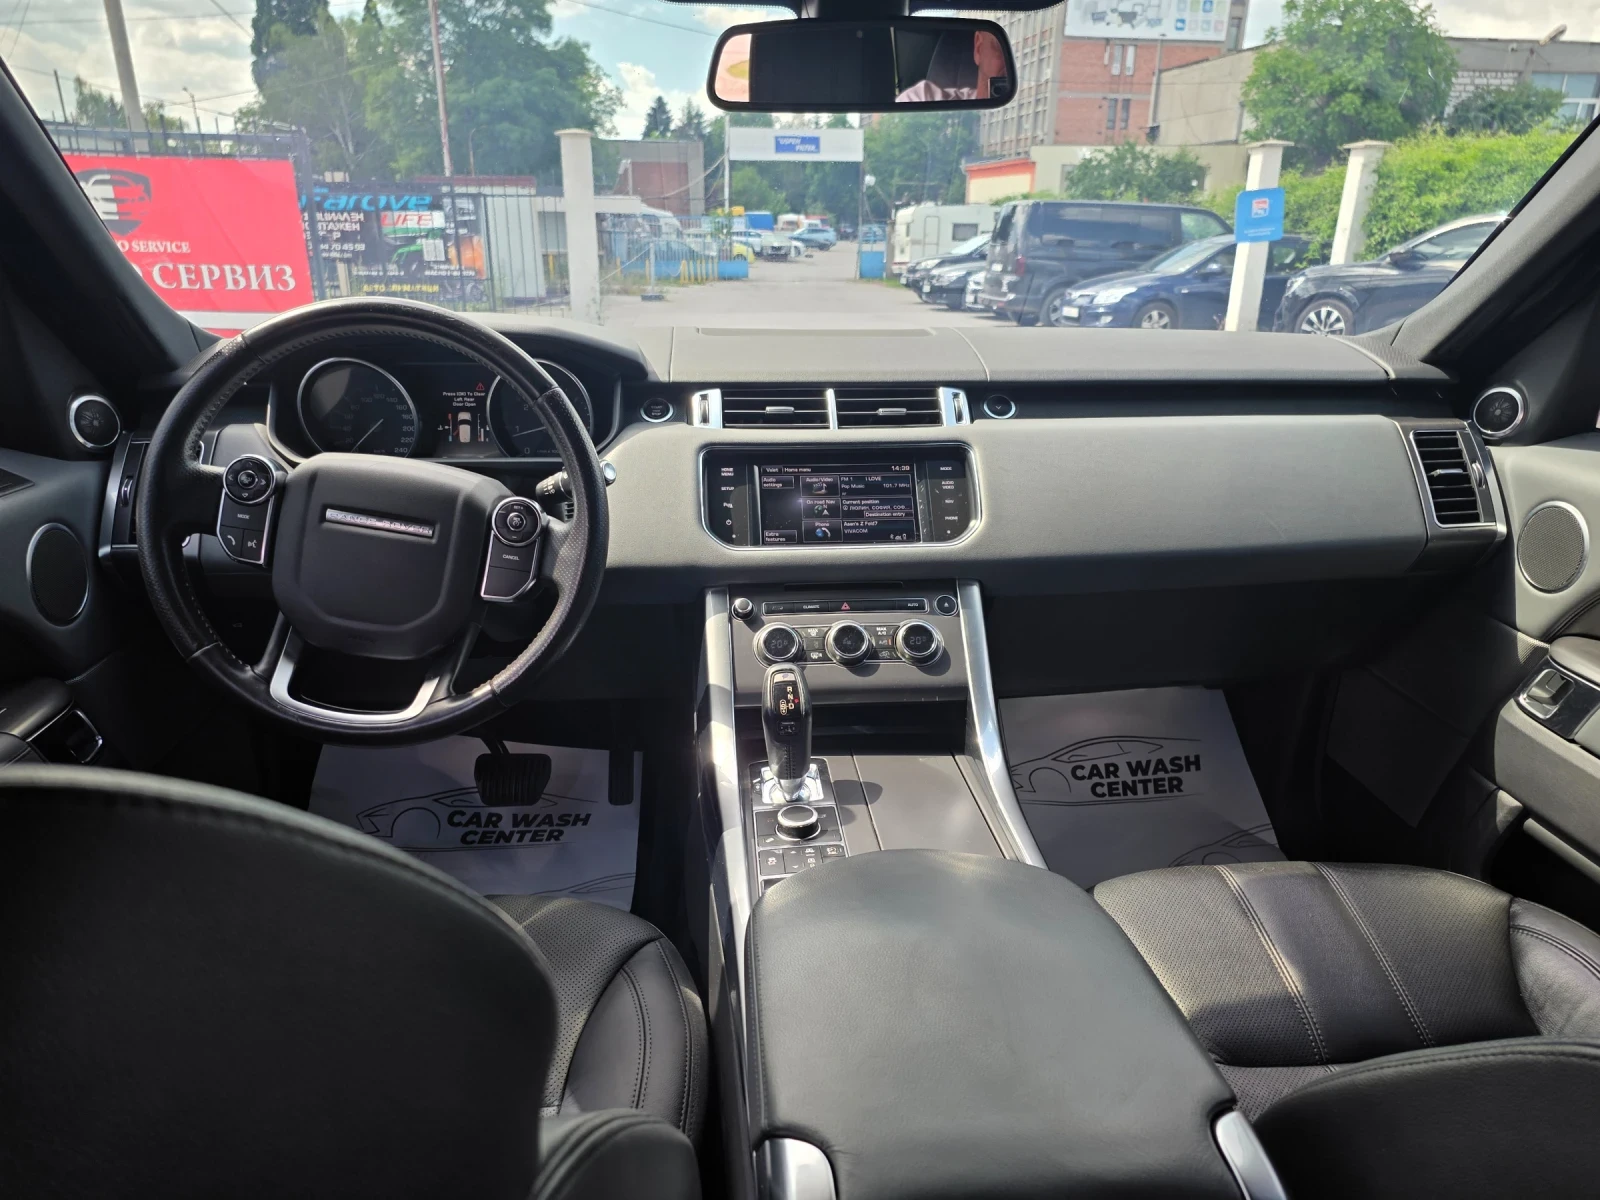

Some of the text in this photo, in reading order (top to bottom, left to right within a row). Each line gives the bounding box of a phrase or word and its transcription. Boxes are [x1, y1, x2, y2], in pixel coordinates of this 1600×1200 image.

[382, 212, 433, 226] LIFE
[132, 240, 190, 254] SERVICE
[152, 263, 296, 291] СЕРВИЗ
[1070, 754, 1201, 780] CAR WASH
[1090, 776, 1183, 798] CENTER
[447, 810, 592, 829] CAR WASH
[460, 829, 564, 845] CENTER
